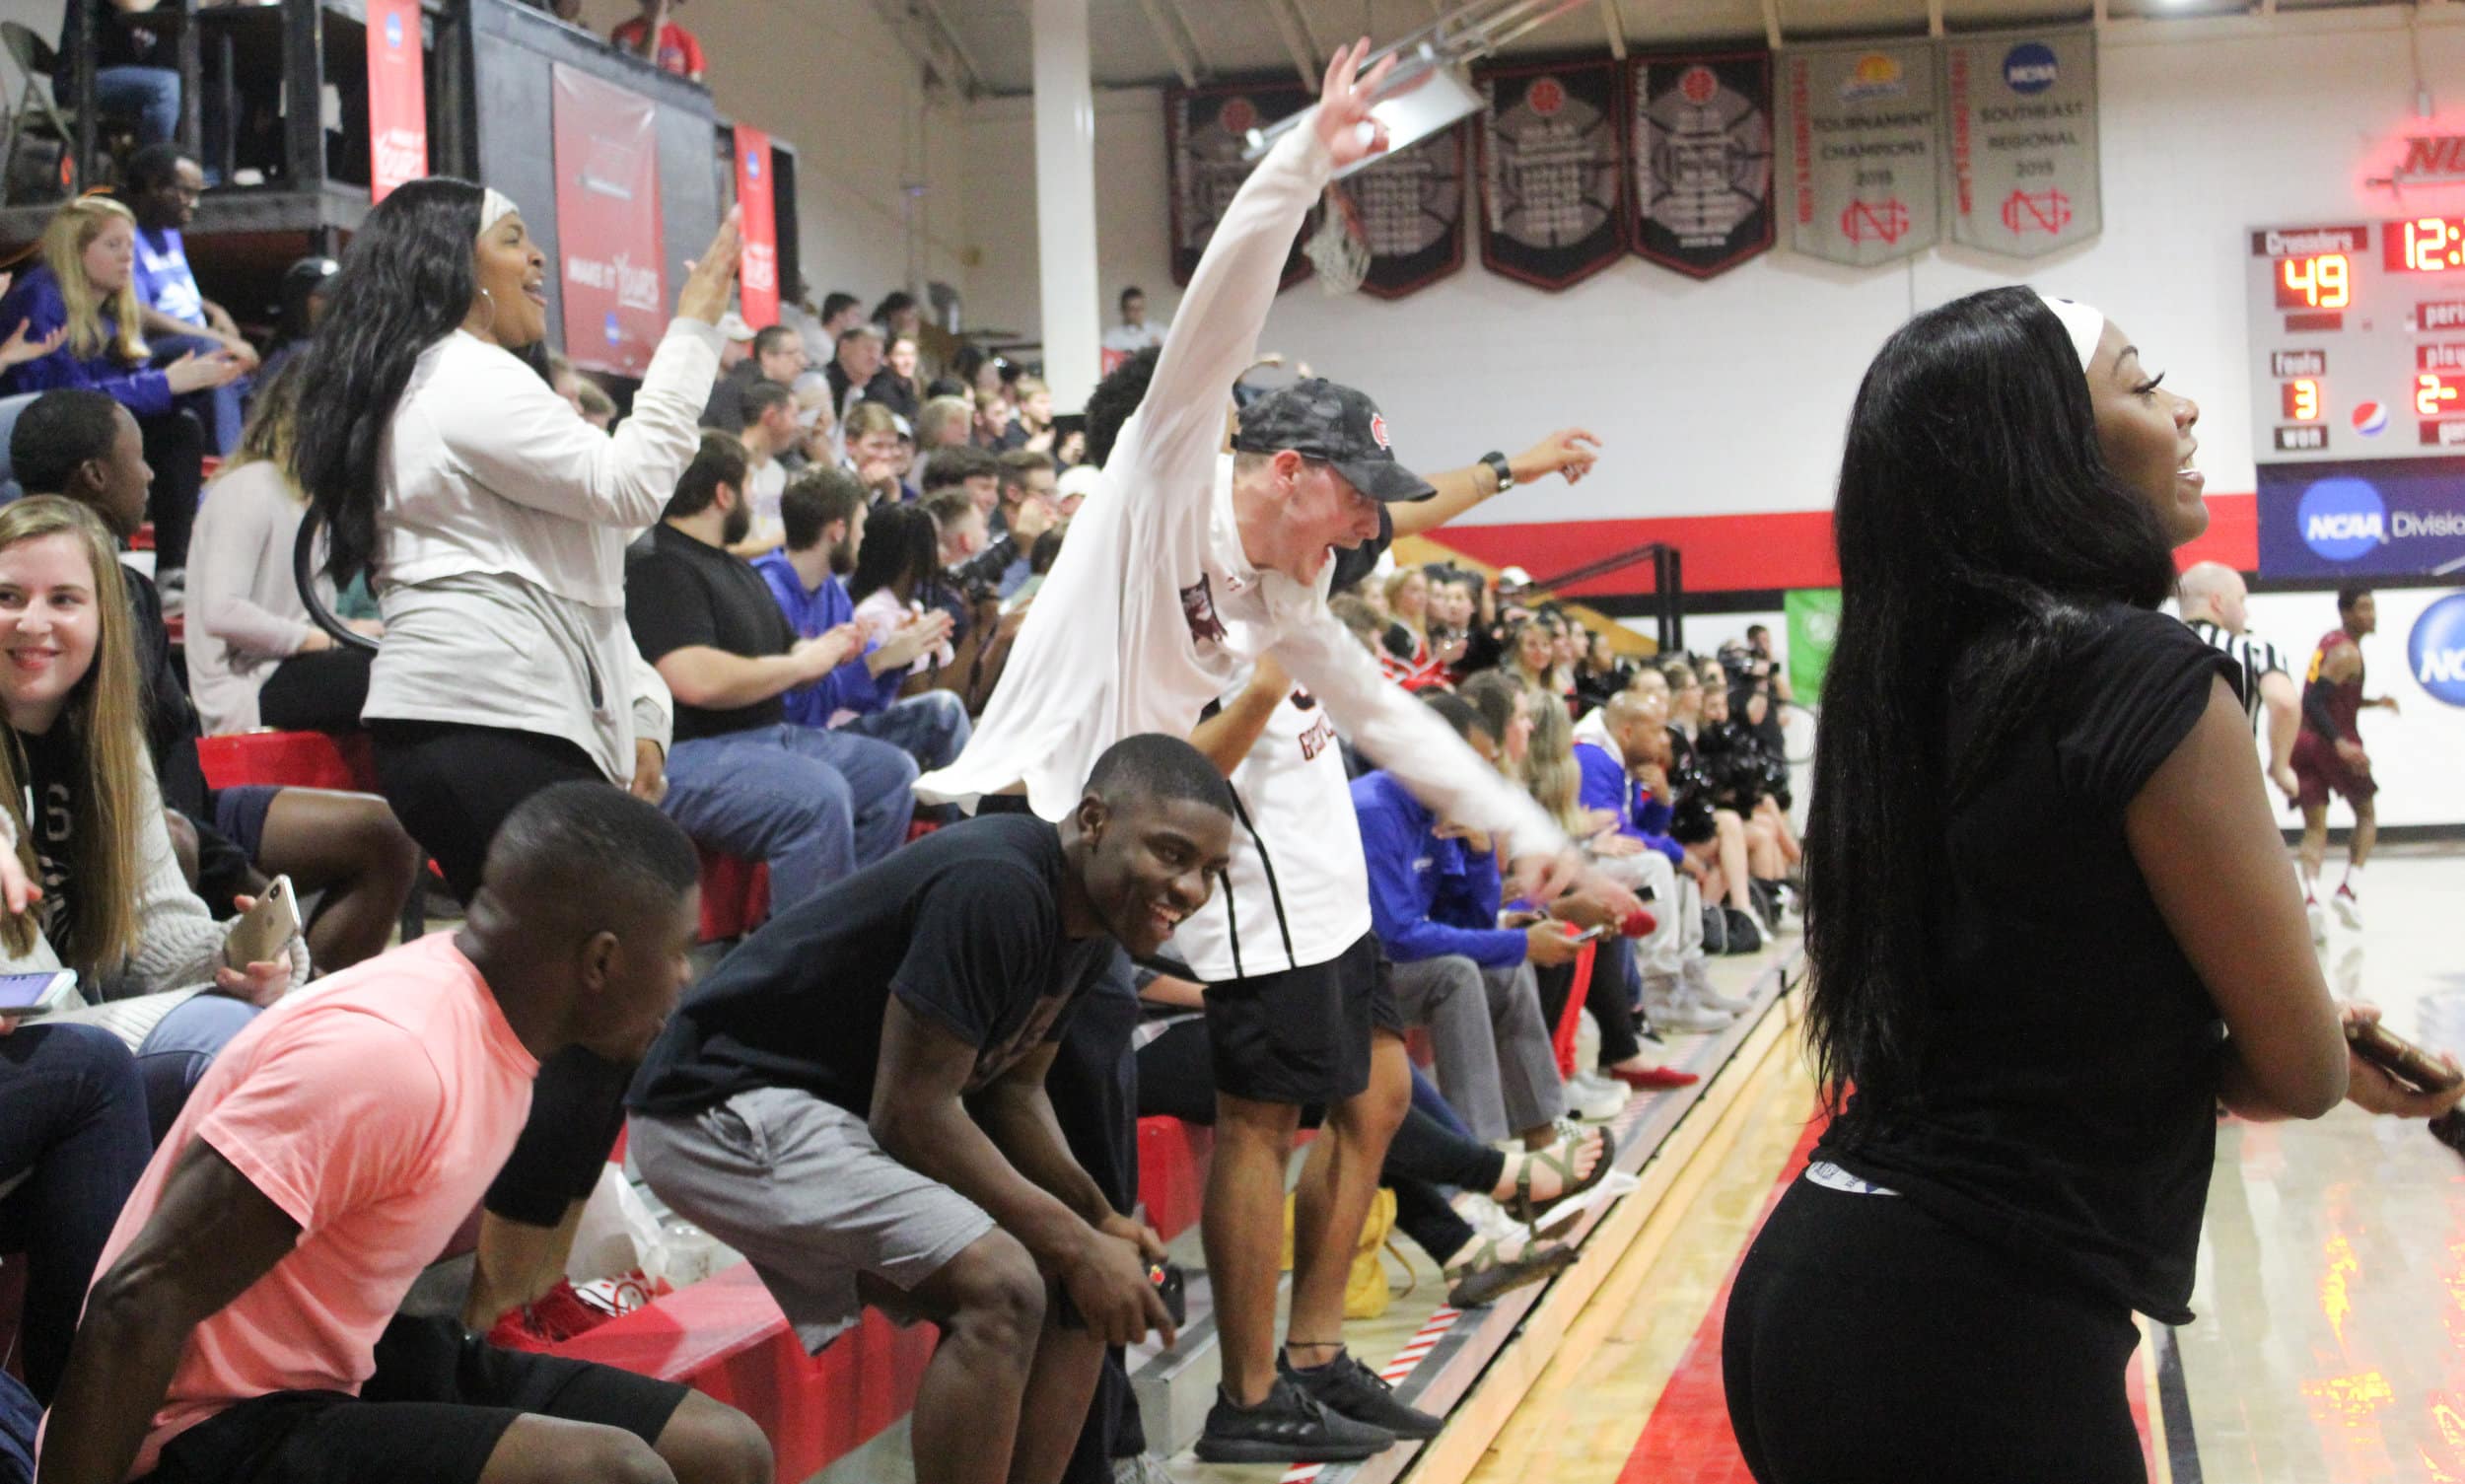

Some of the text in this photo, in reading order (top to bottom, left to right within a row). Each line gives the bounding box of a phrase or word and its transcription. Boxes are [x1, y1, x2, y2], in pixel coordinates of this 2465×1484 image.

[1812, 109, 1933, 132] TOURNAMENT
[1981, 101, 2083, 123] SOUTHEAST
[1822, 141, 1926, 162] CHAMPIONS
[1987, 132, 2078, 151] REGIONAL
[2266, 231, 2352, 256] Crusaders
[2405, 218, 2465, 271] 12:
[2285, 253, 2350, 309] 49
[2293, 379, 2317, 420] 3
[2282, 428, 2321, 450] won
[2307, 512, 2383, 541] NCAA
